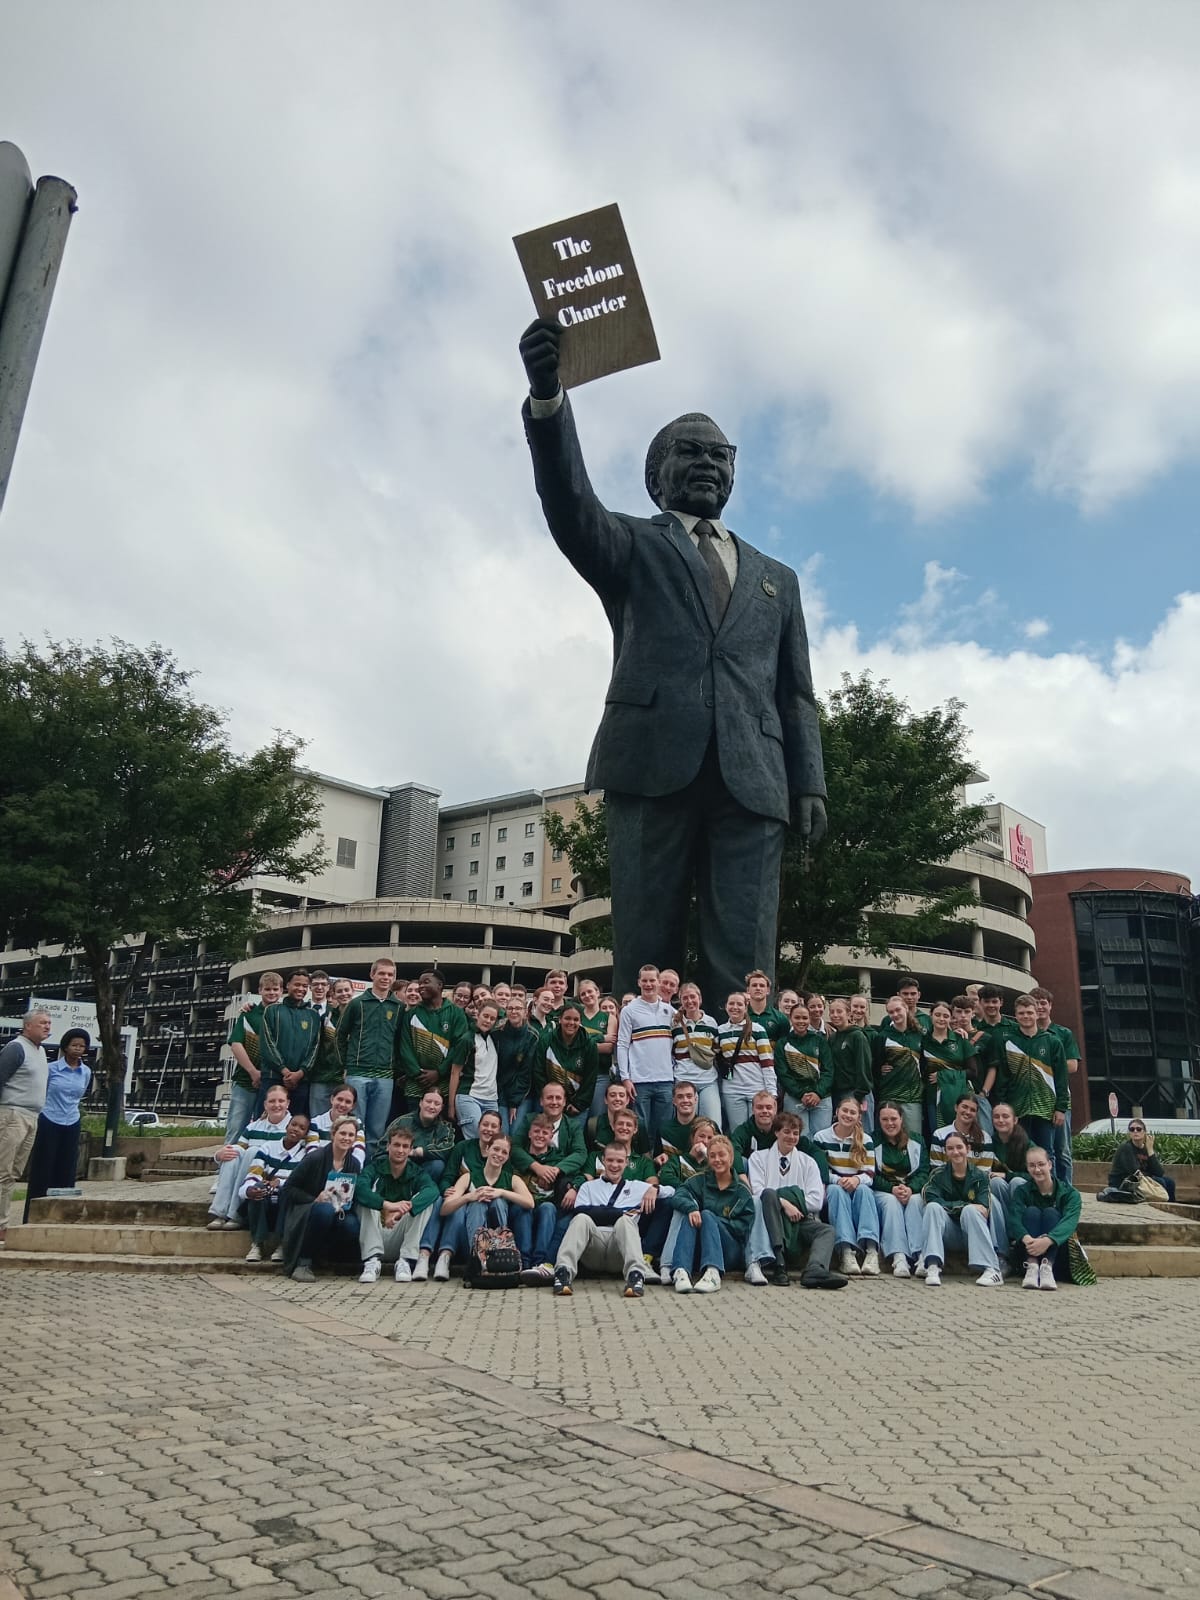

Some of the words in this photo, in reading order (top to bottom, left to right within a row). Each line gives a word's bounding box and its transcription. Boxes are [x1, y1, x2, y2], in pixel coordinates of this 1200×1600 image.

[553, 238, 592, 260] The
[542, 263, 624, 300] Freedom
[558, 295, 627, 328] Charter
